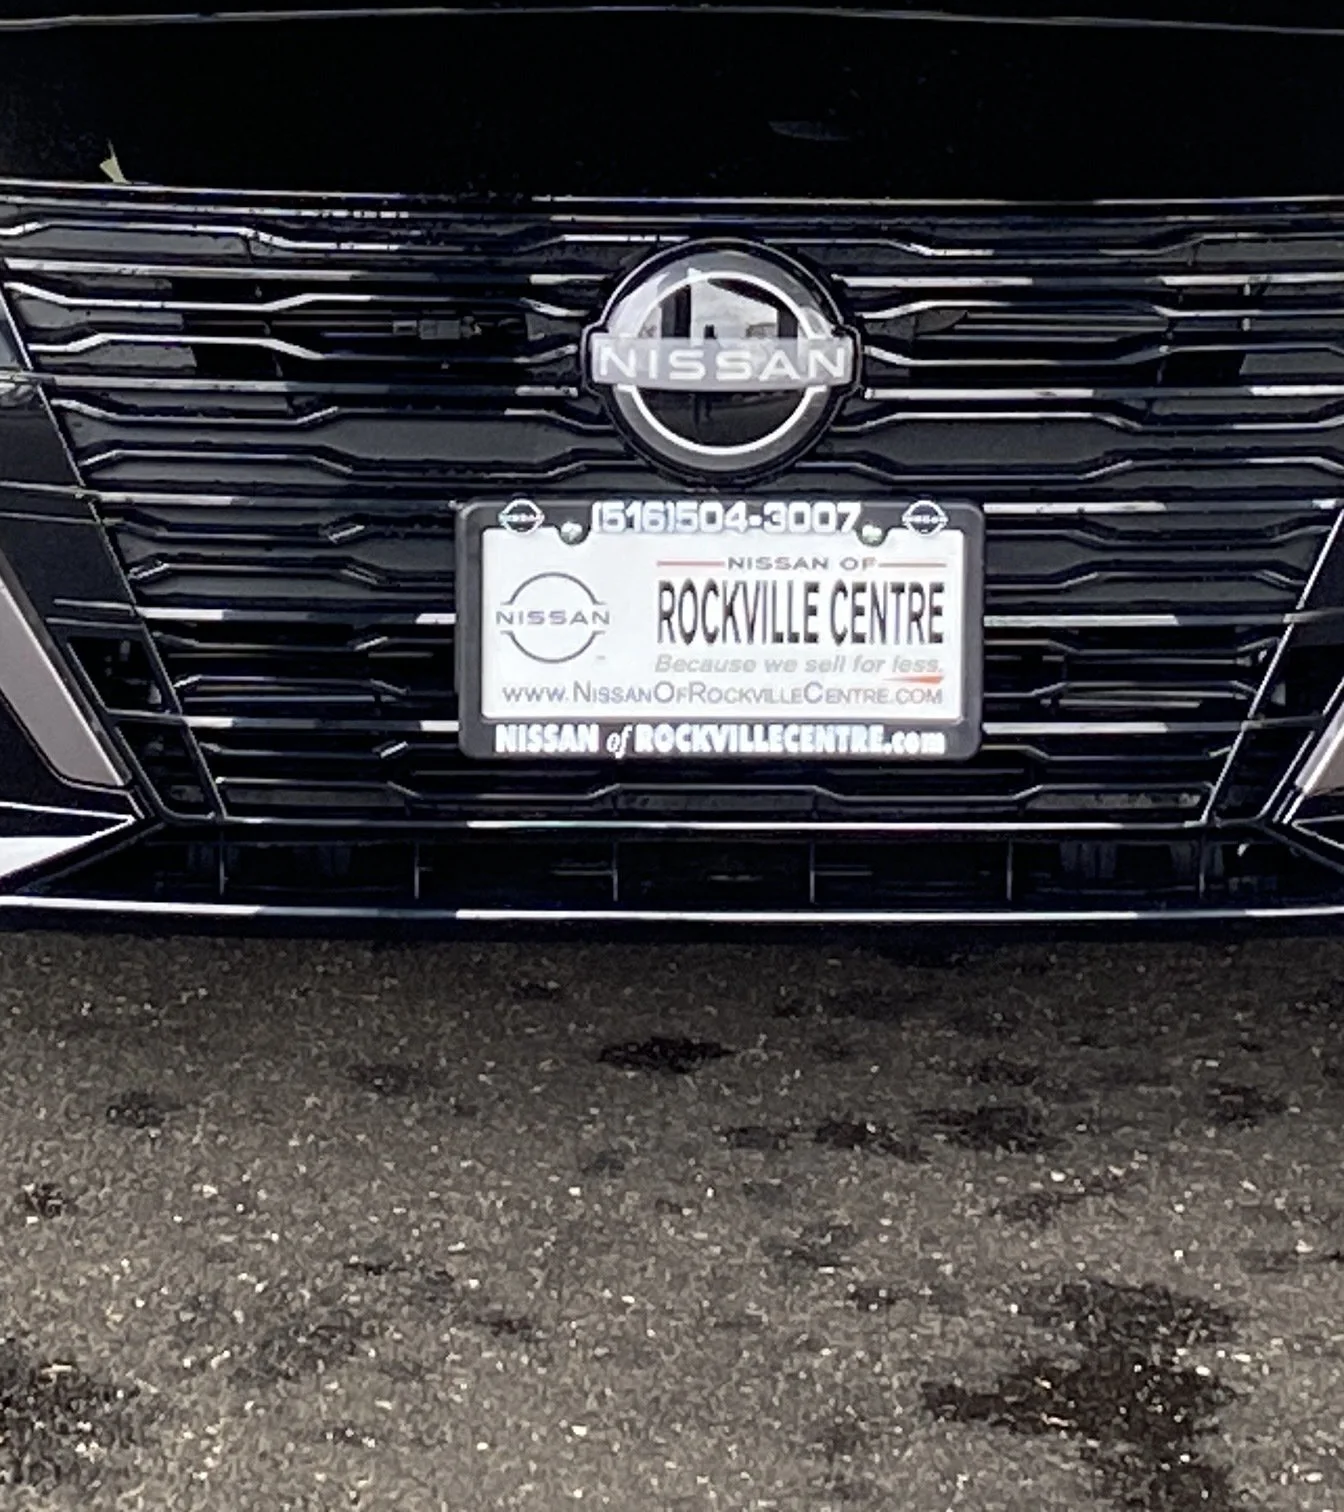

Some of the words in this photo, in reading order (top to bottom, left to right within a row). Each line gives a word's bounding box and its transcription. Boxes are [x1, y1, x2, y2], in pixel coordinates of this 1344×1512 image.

[598, 345, 846, 381] NISSAN
[727, 556, 829, 571] NISSAN
[839, 556, 877, 571] OF
[495, 610, 611, 626] NISSAN
[658, 578, 820, 645] ROCKVILLE
[830, 578, 945, 646] CENTRE
[655, 653, 757, 673] Because
[764, 658, 798, 673] we
[805, 654, 846, 673] sell
[852, 654, 886, 673] for
[494, 723, 600, 753] NISSAN
[605, 725, 633, 760] of
[634, 723, 946, 755] ROCKVILLECENTRE.com
